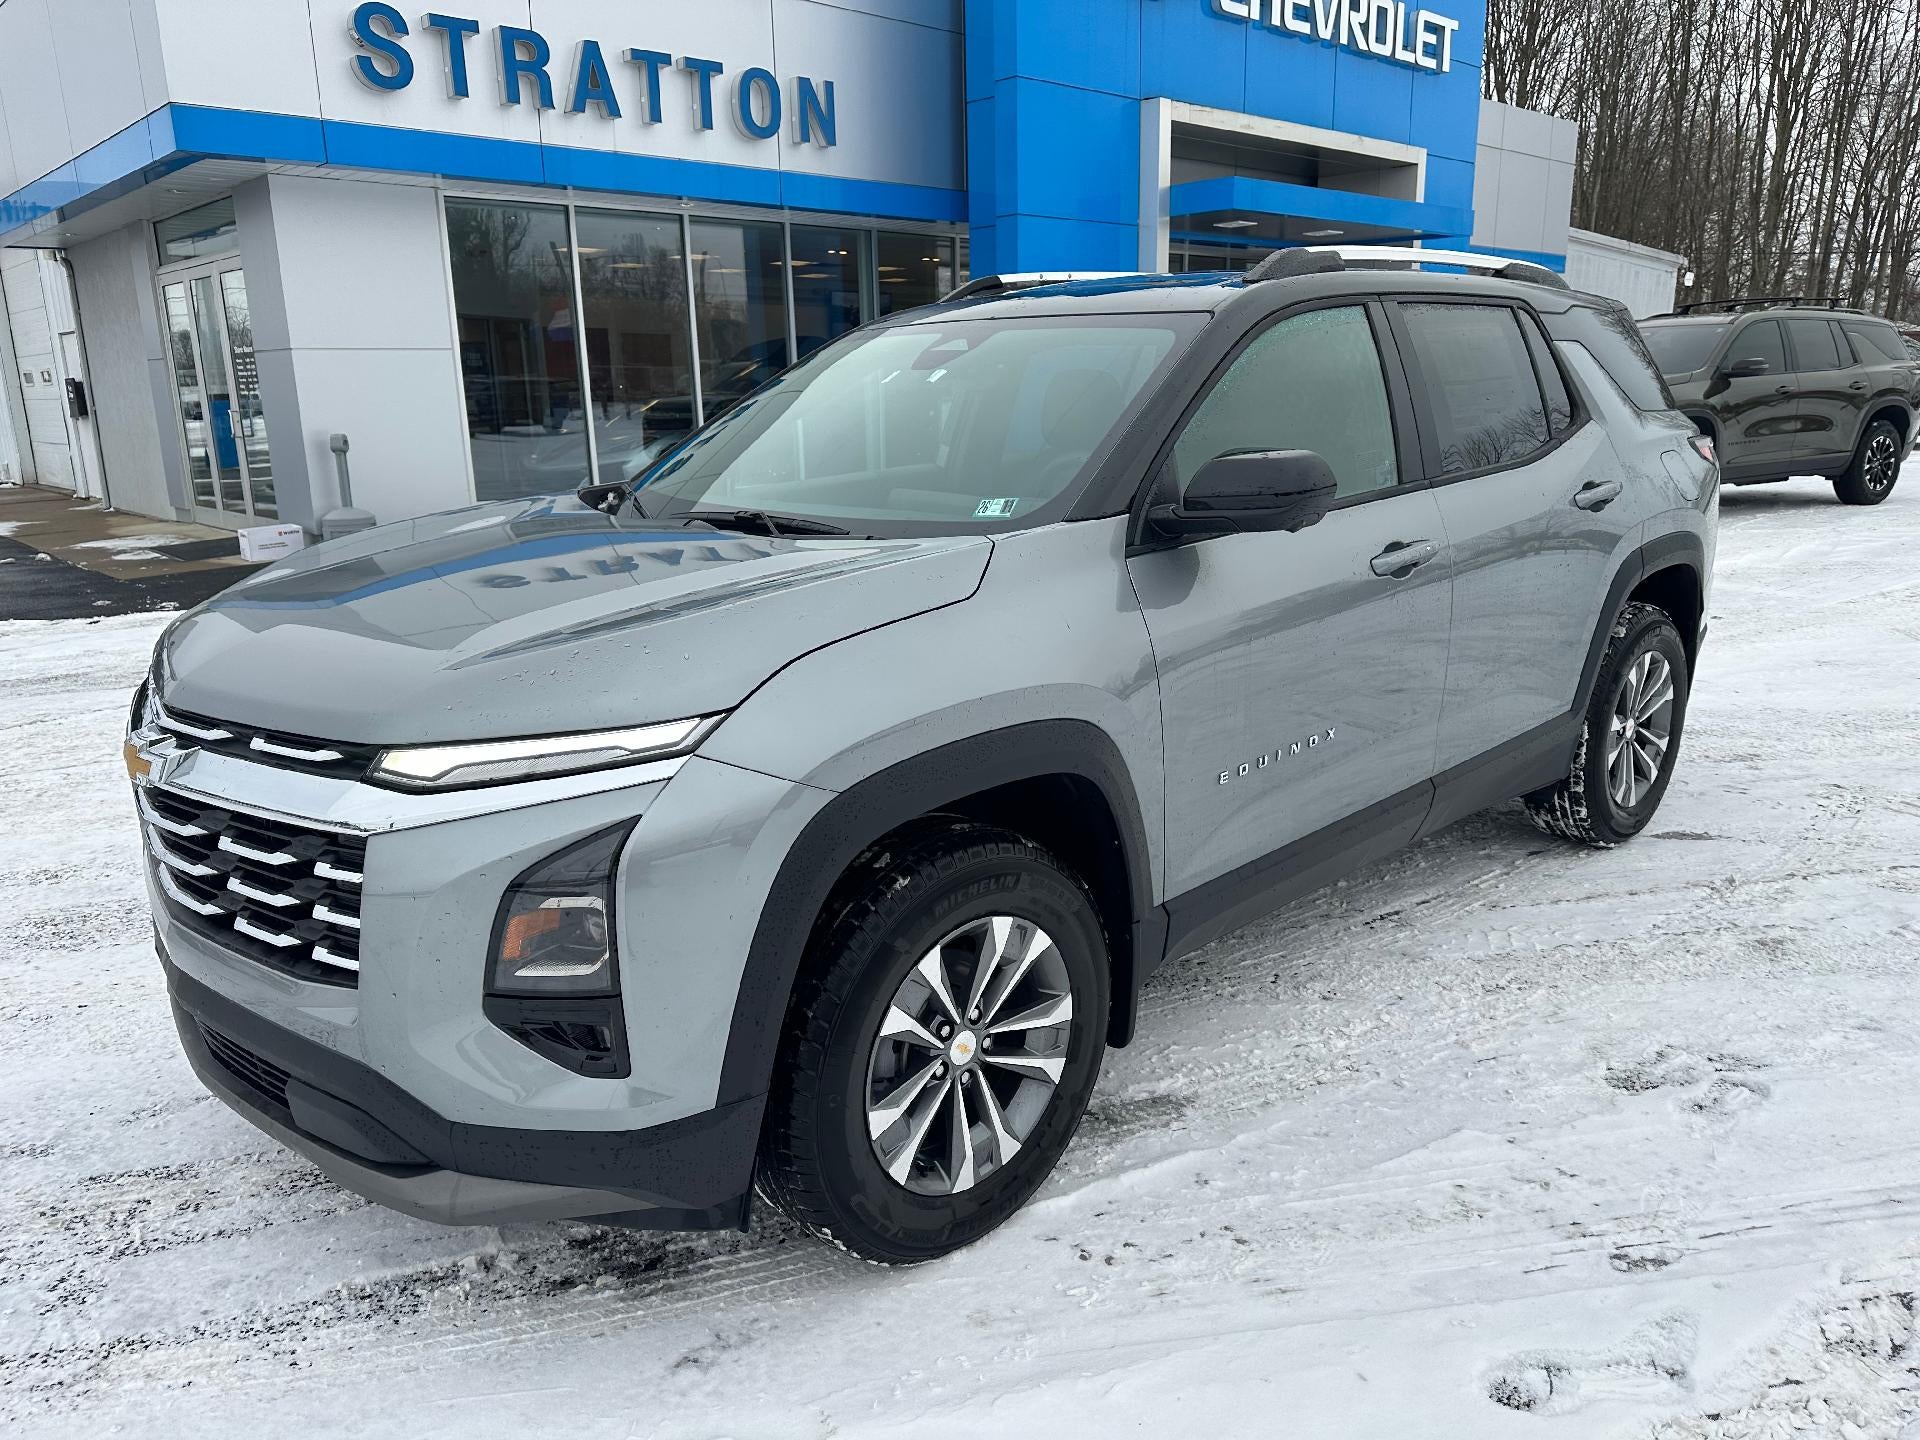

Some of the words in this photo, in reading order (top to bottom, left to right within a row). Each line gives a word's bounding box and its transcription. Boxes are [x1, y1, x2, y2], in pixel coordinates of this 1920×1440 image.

[1217, 0, 1460, 73] EVROLET
[349, 1, 837, 148] STRATTON
[1218, 727, 1337, 785] EQUINOX
[935, 874, 1018, 919] MICHELIN
